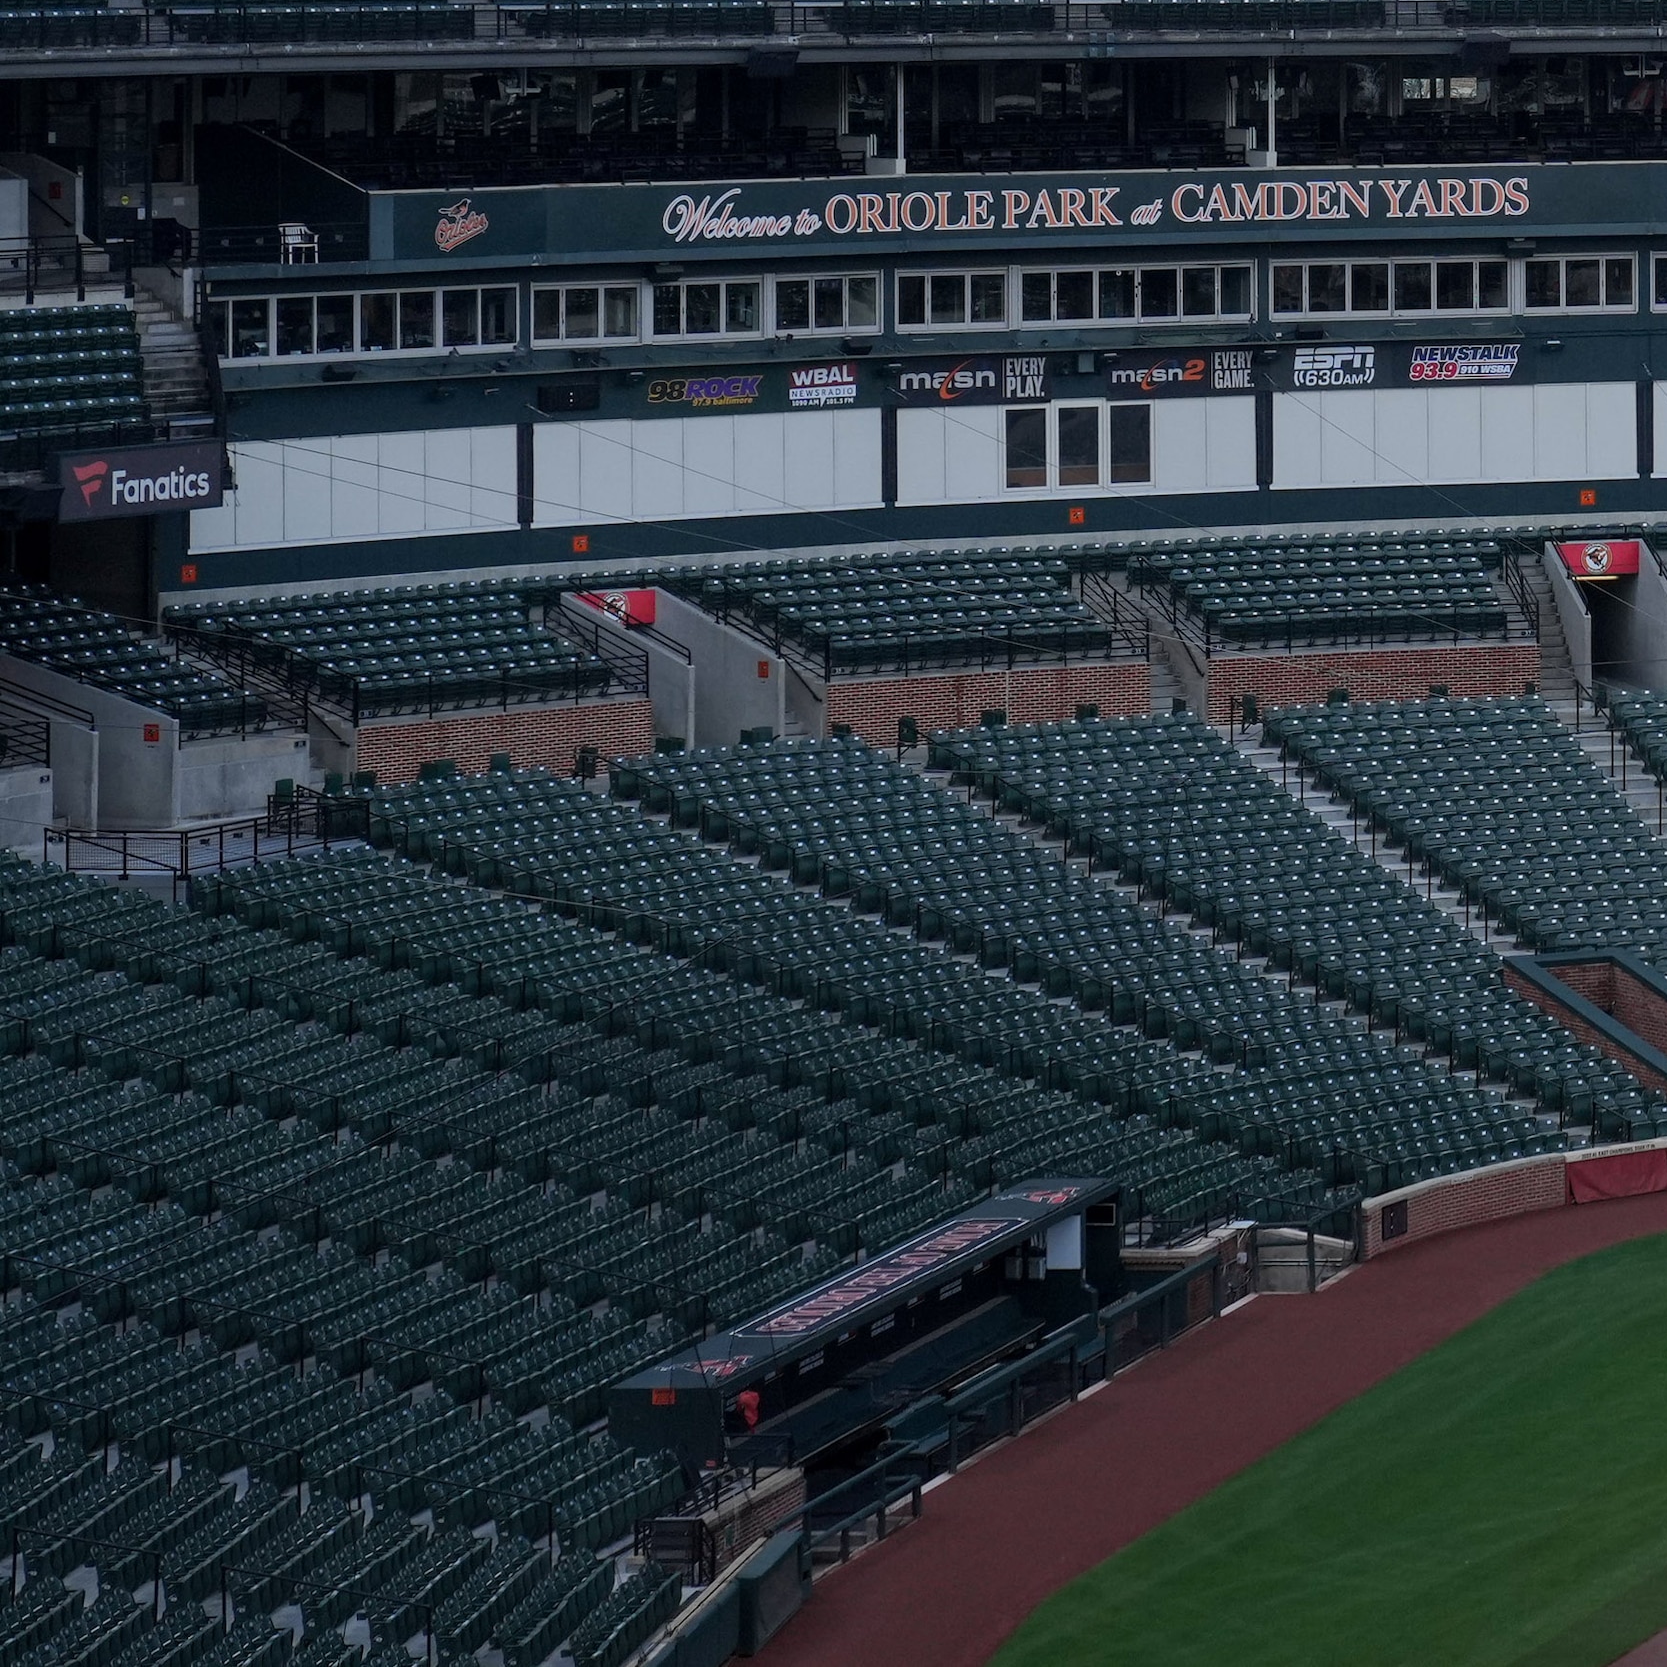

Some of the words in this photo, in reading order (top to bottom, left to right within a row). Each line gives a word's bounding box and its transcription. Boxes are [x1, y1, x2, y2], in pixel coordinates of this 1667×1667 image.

[662, 188, 791, 243] Welcome
[794, 208, 823, 236] to
[825, 191, 995, 233] ORIOLE
[1001, 187, 1123, 230] PARK
[1130, 198, 1164, 226] at
[1171, 180, 1370, 222] CAMDEN
[1378, 178, 1530, 219] YARDS
[1214, 351, 1254, 370] EVERY
[1294, 345, 1375, 370] ESPN
[1411, 344, 1521, 363] NEWSTALK
[791, 364, 854, 386] WBAL
[1005, 357, 1047, 377] EVERY
[1409, 361, 1458, 380] 93.9
[1459, 365, 1479, 375] 910
[900, 369, 996, 390] masn
[1006, 377, 1046, 399] PLAY.
[1214, 369, 1255, 389] GAME.
[713, 397, 754, 406] baltimore
[791, 387, 854, 398] NEWSRADIO
[111, 465, 210, 506] Fanatics
